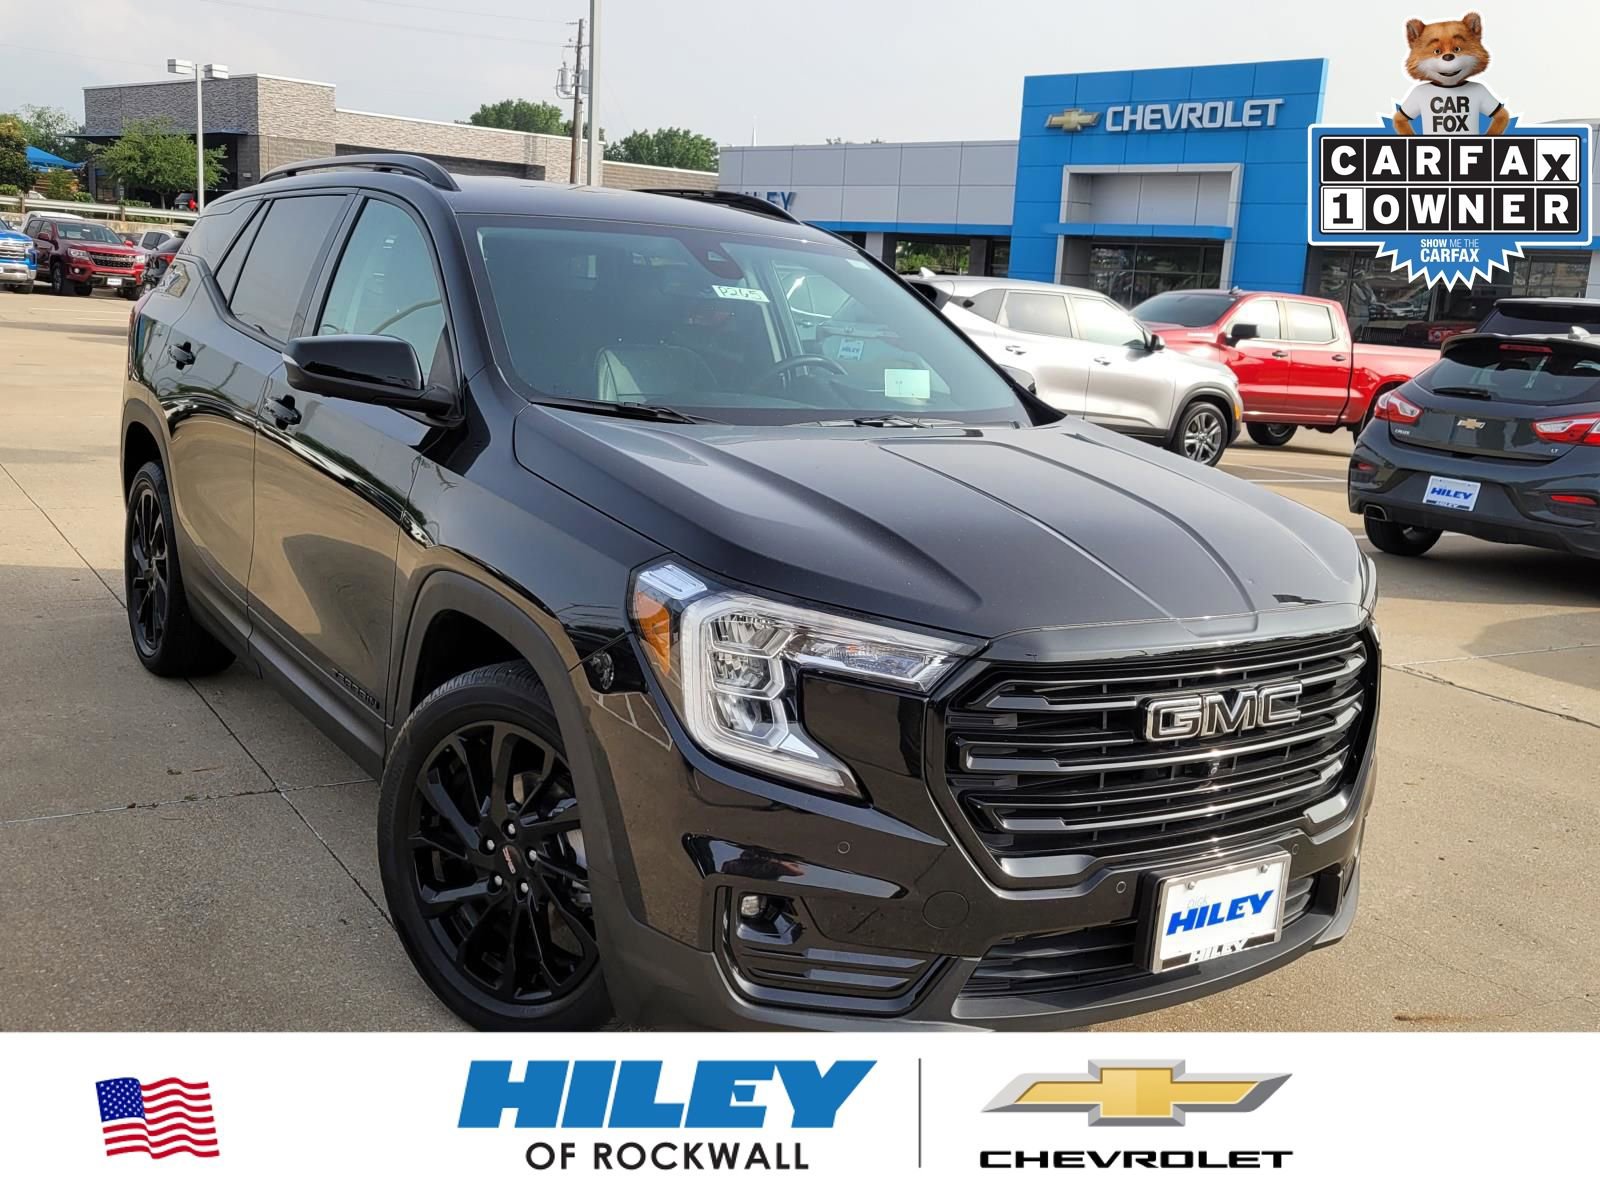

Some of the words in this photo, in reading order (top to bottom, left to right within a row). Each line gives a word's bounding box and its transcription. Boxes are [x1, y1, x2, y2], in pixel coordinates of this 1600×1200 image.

[1105, 98, 1285, 132] CHEVROLET
[1431, 487, 1473, 500] HILEY
[1146, 683, 1302, 742] GMC
[1166, 889, 1274, 936] HILEY
[1188, 938, 1249, 963] HILEY
